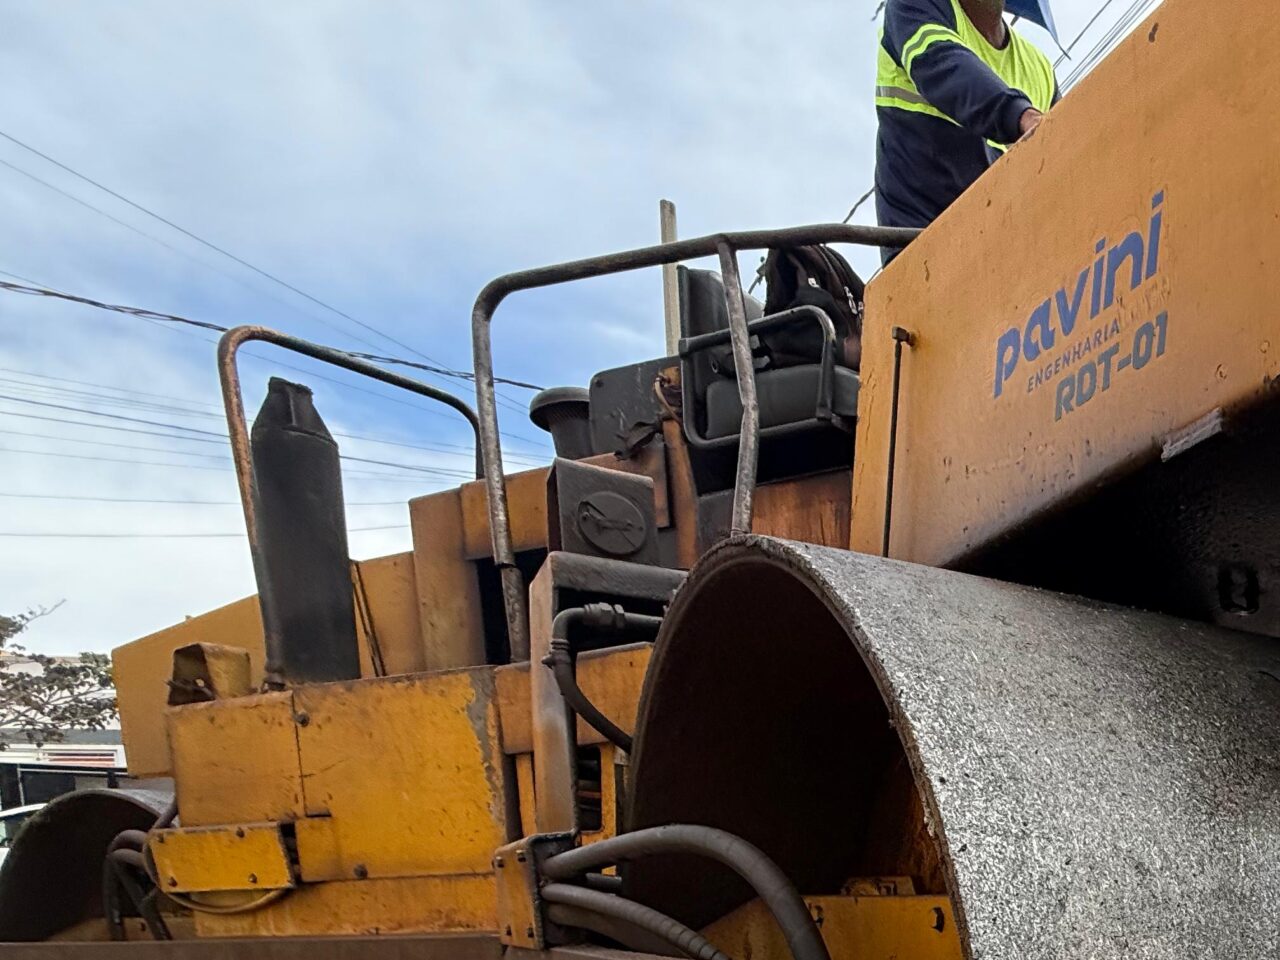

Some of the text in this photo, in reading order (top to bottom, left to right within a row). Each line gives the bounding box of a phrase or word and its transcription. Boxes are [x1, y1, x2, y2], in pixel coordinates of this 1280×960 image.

[993, 189, 1164, 399] pavini
[1027, 318, 1121, 394] ENGENHARIA
[1054, 310, 1168, 422] RDT-01
